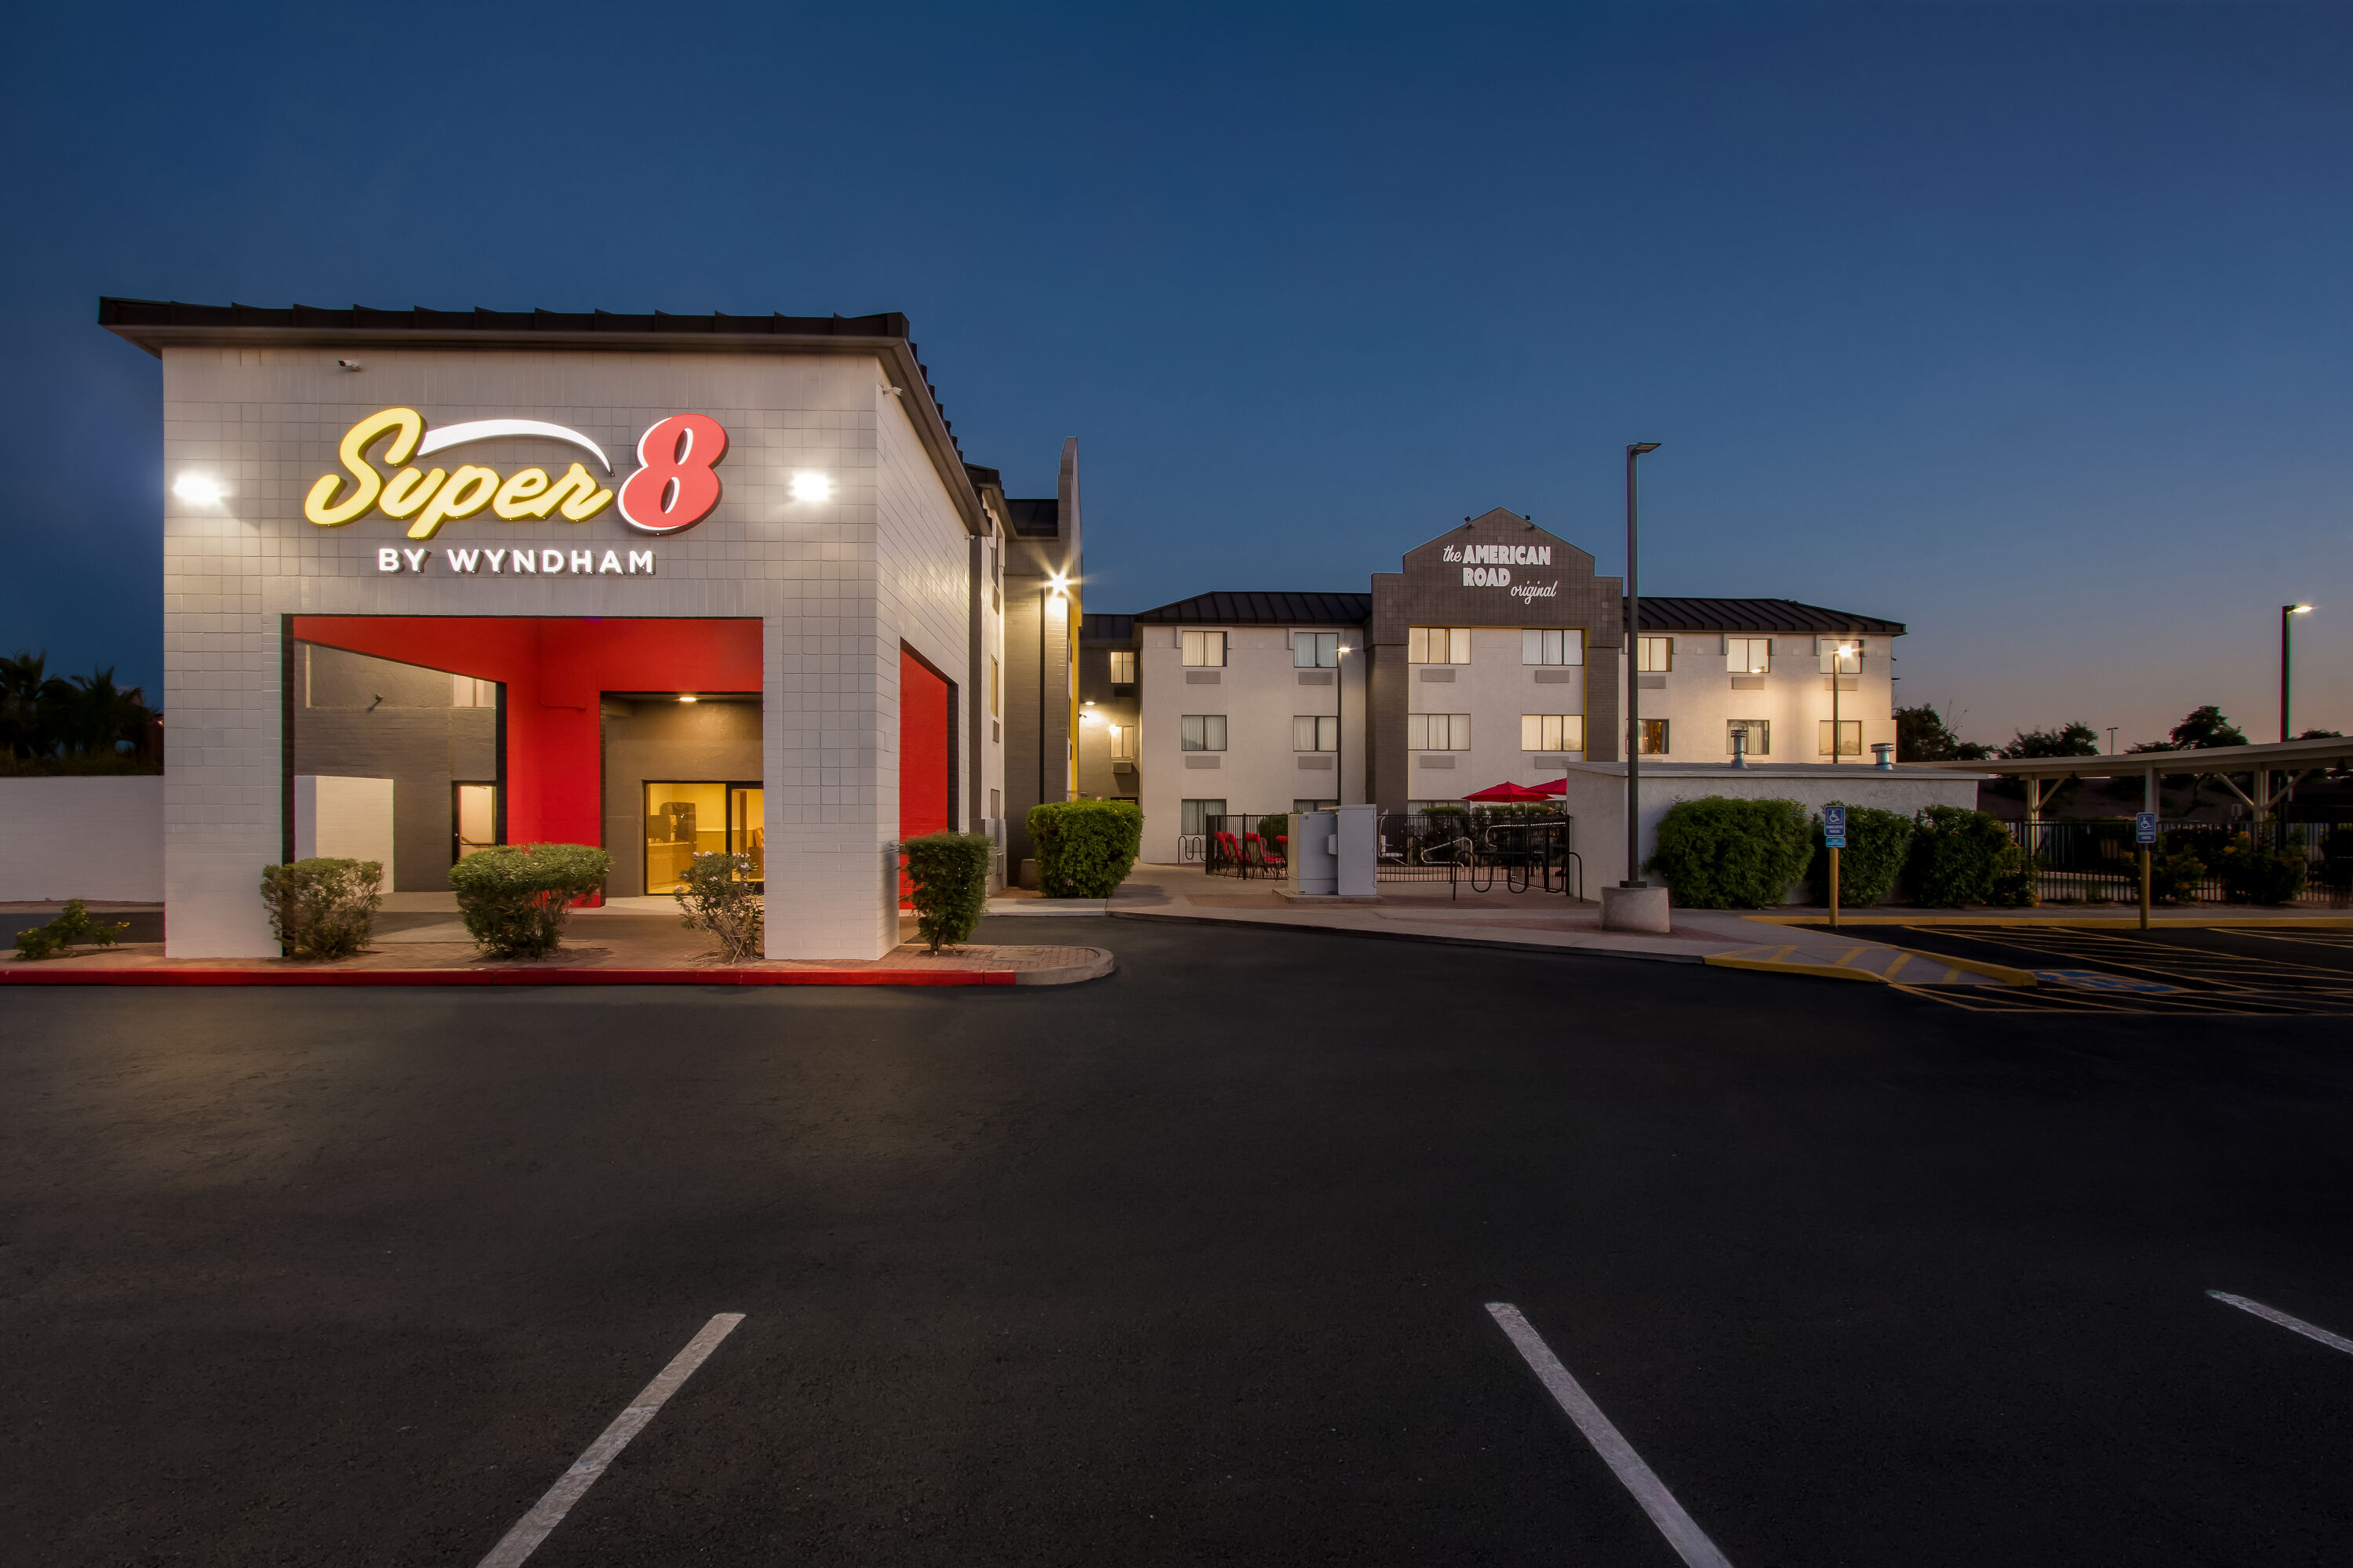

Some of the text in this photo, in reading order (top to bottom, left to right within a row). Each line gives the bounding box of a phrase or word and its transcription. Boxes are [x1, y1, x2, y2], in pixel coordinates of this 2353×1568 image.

[304, 407, 729, 539] Super 8
[379, 548, 656, 574] BY WYNDHAM
[1442, 544, 1551, 566] the AMERICAN
[1462, 567, 1511, 588] ROAD
[1510, 580, 1558, 605] original
